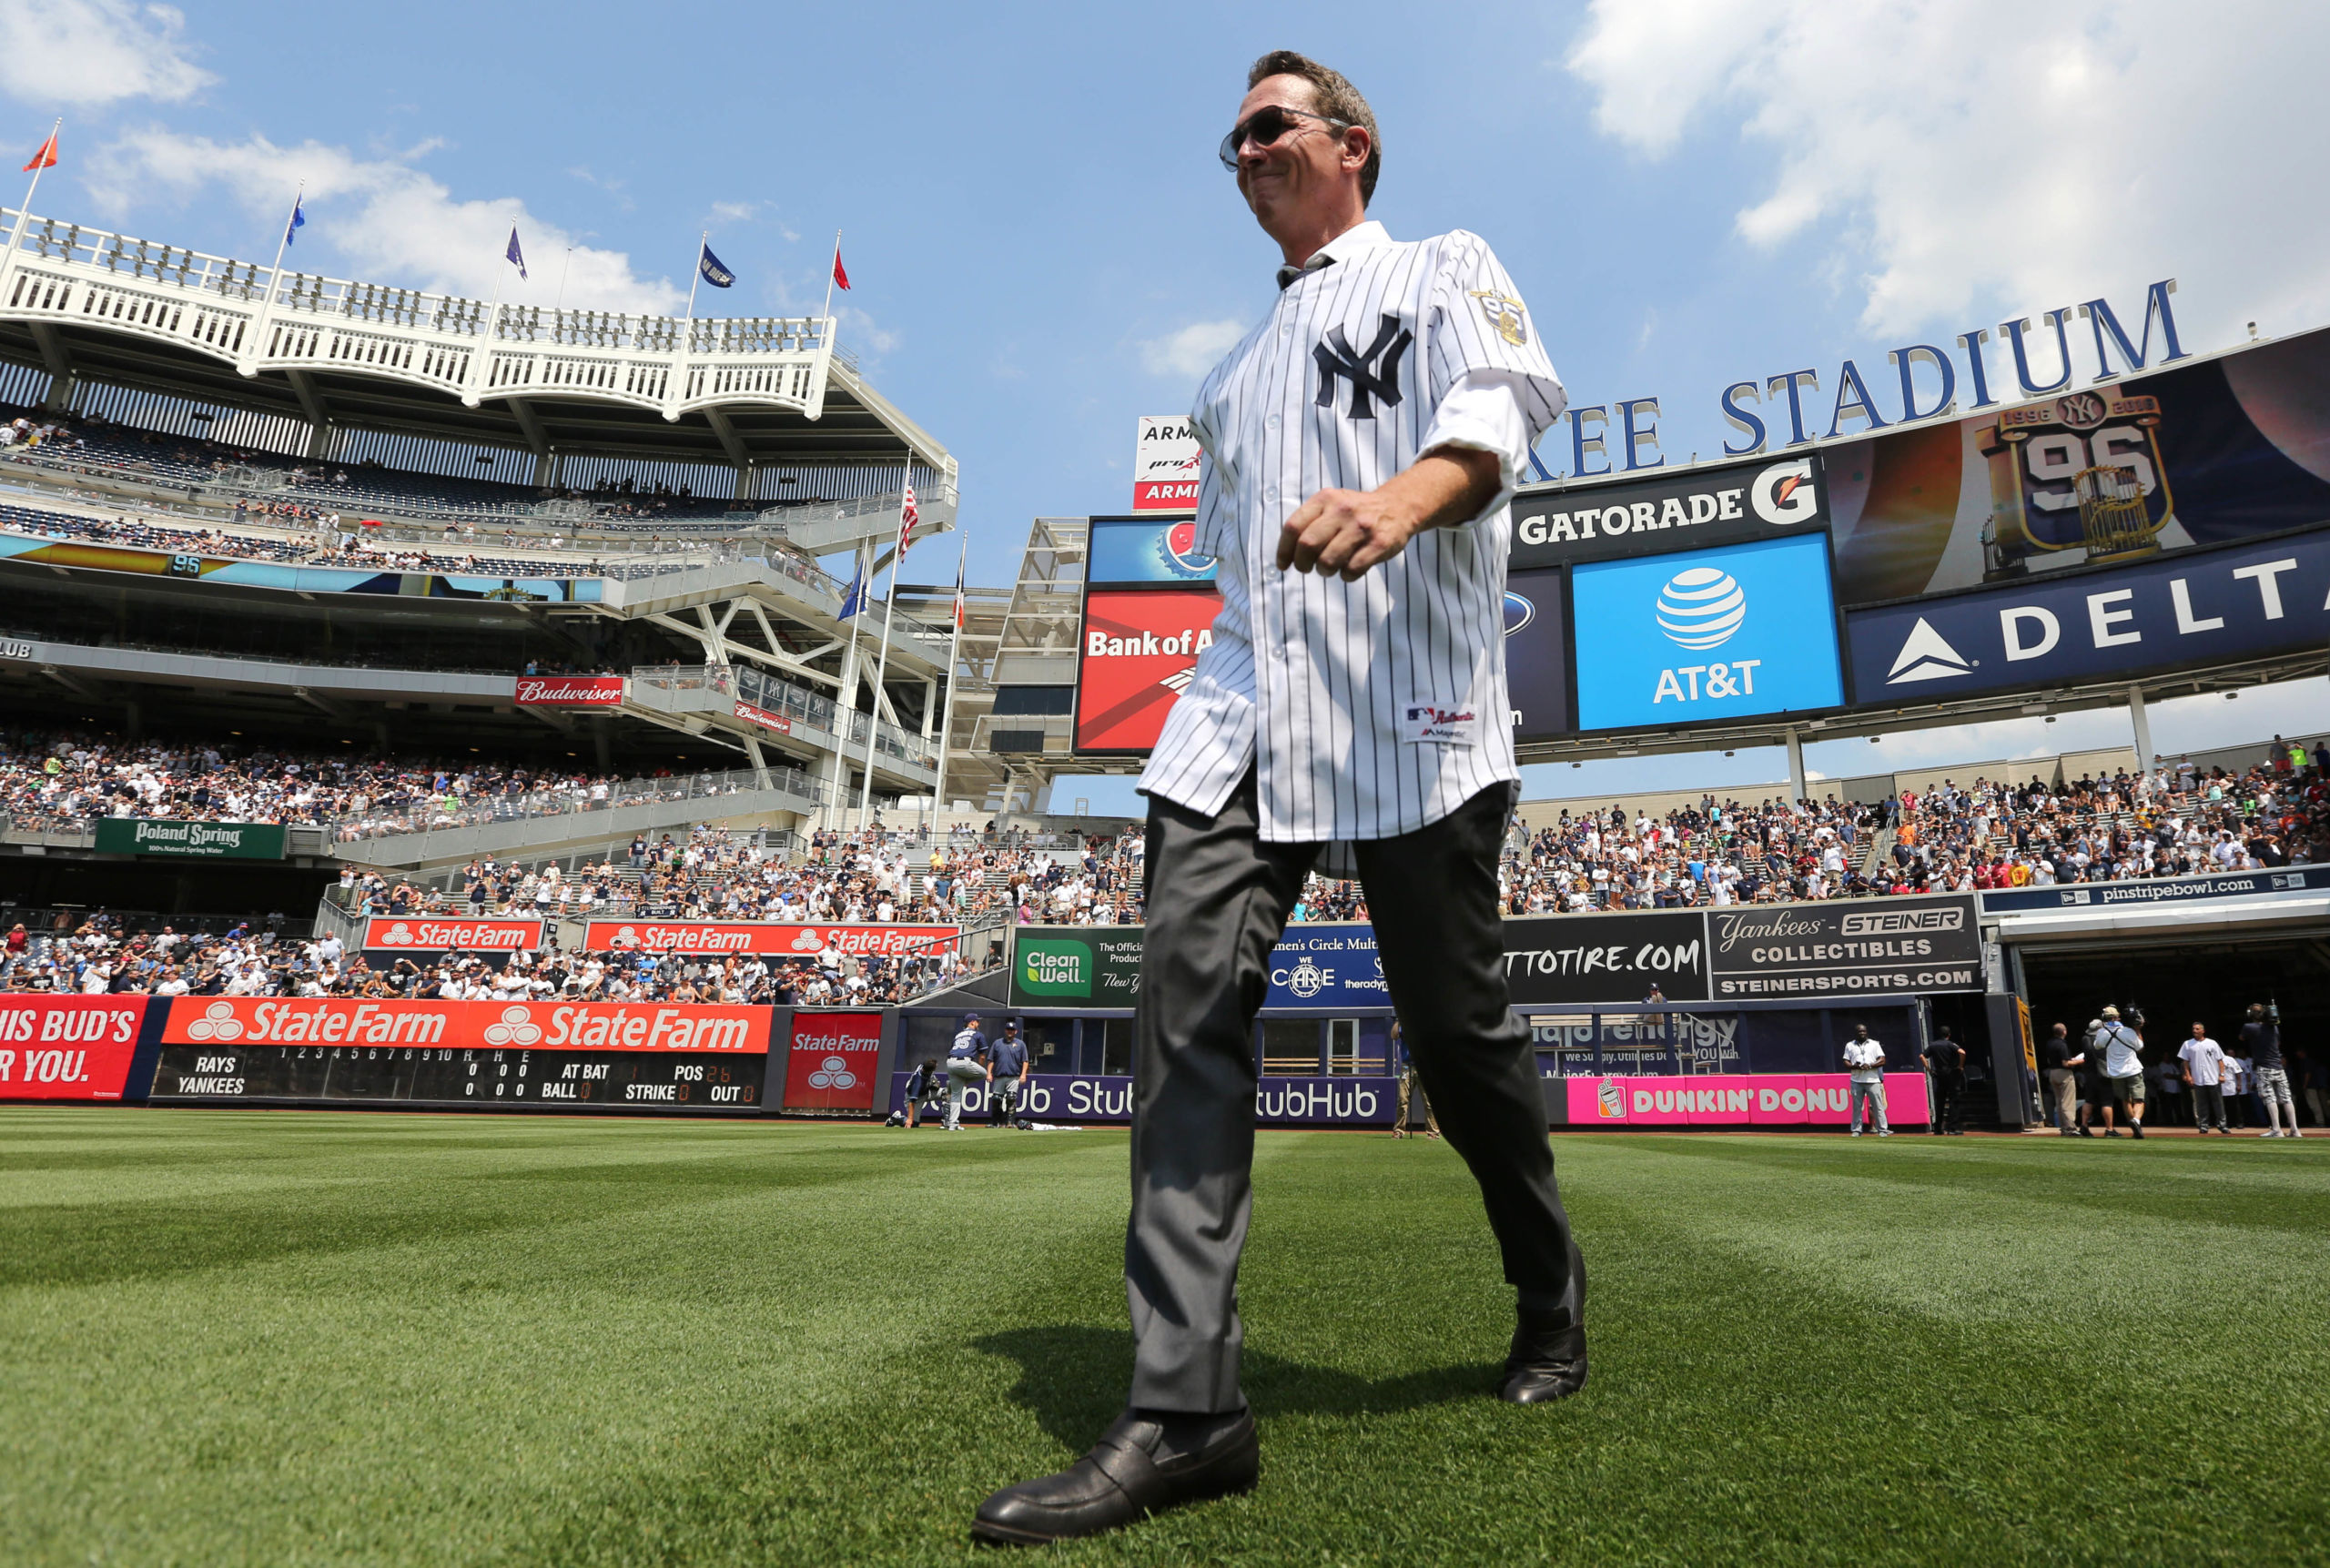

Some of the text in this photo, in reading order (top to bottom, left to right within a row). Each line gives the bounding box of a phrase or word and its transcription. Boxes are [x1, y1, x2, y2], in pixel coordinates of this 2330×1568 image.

[1312, 312, 1413, 420] NY
[1720, 278, 2193, 460] STADIUM
[2002, 409, 2051, 426] 1996
[2026, 424, 2157, 512] 96
[1518, 487, 1745, 546] GATORADE
[173, 554, 200, 574] 96
[2000, 556, 2330, 663] DELT
[1088, 630, 1160, 657] Bank
[1162, 629, 1192, 656] of
[517, 681, 623, 702] Budweiser
[1652, 659, 1762, 704] AT&T
[734, 703, 790, 732] Budweiser
[135, 822, 240, 847] Poland Spring
[2102, 879, 2255, 903] pinstripebowl.com
[1717, 910, 1821, 953] Yankees
[1845, 910, 1960, 932] STEINER
[1099, 943, 1115, 952] The
[1272, 938, 1306, 951] men's
[1309, 938, 1343, 951] Circle
[1751, 938, 1932, 964] COLLECTIBLES
[1027, 952, 1079, 967] Clean
[1039, 967, 1079, 983] Well
[1101, 973, 1130, 987] New
[1720, 970, 1973, 994] STEINERSPORTS.COM
[280, 1047, 531, 1063] 1 2 3 4 5 6 7 8 9 10 R H E
[1693, 1047, 1717, 1060] YOU
[23, 1049, 89, 1083] YOU.
[196, 1057, 528, 1077] RAYS 0 0 0
[561, 1064, 580, 1079] AT
[582, 1065, 610, 1080] BAT
[674, 1066, 704, 1081] POS
[178, 1077, 524, 1097] YANKEES 0 0 0
[542, 1083, 577, 1098] BALL
[625, 1084, 676, 1100] STRIKE
[710, 1086, 741, 1102] OUT
[1633, 1088, 1851, 1113] DUNKIN' DONU
